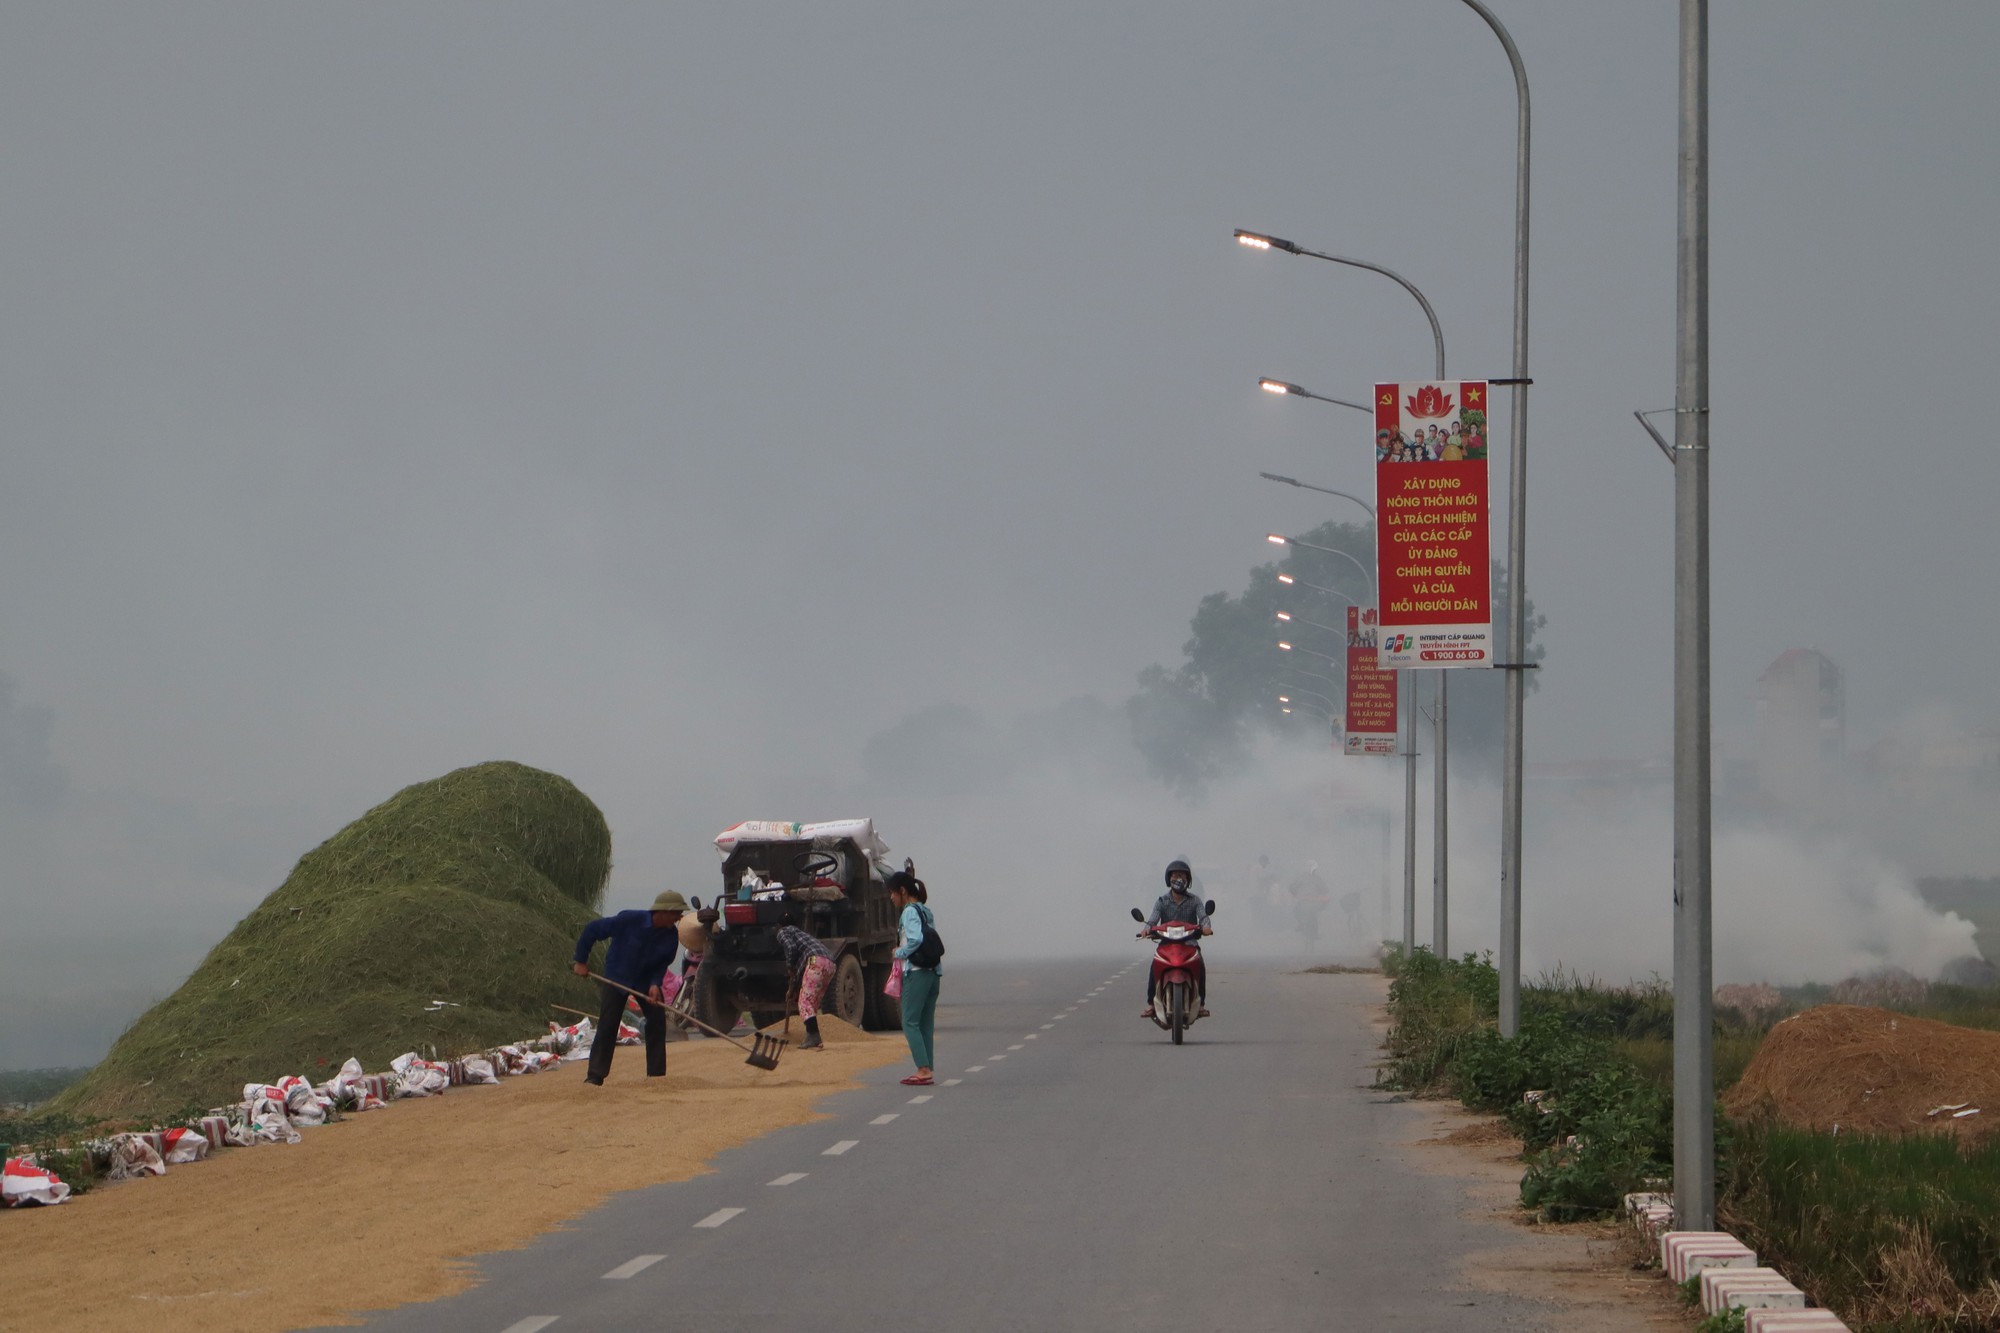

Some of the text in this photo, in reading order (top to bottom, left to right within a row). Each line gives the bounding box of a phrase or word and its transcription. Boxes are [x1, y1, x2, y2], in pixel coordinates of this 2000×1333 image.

[1404, 477, 1461, 491] XÂY DỰNG
[1387, 493, 1477, 507] NÔNG THÔN MỚI
[1389, 511, 1476, 526] LÀ TRÁCH NHIỆM
[1394, 527, 1472, 542] CỦA CÁC CẤP
[1409, 546, 1458, 559] ỦY ĐẢNG
[1396, 561, 1471, 576] CHÍNH QUYỀN
[1413, 580, 1454, 594] VÀ CỦA
[1391, 598, 1478, 612] MỖI NGƯỜI DÂN
[1385, 634, 1413, 653] FPT
[1420, 641, 1442, 649] TRUYỀN
[1468, 651, 1480, 659] 00
